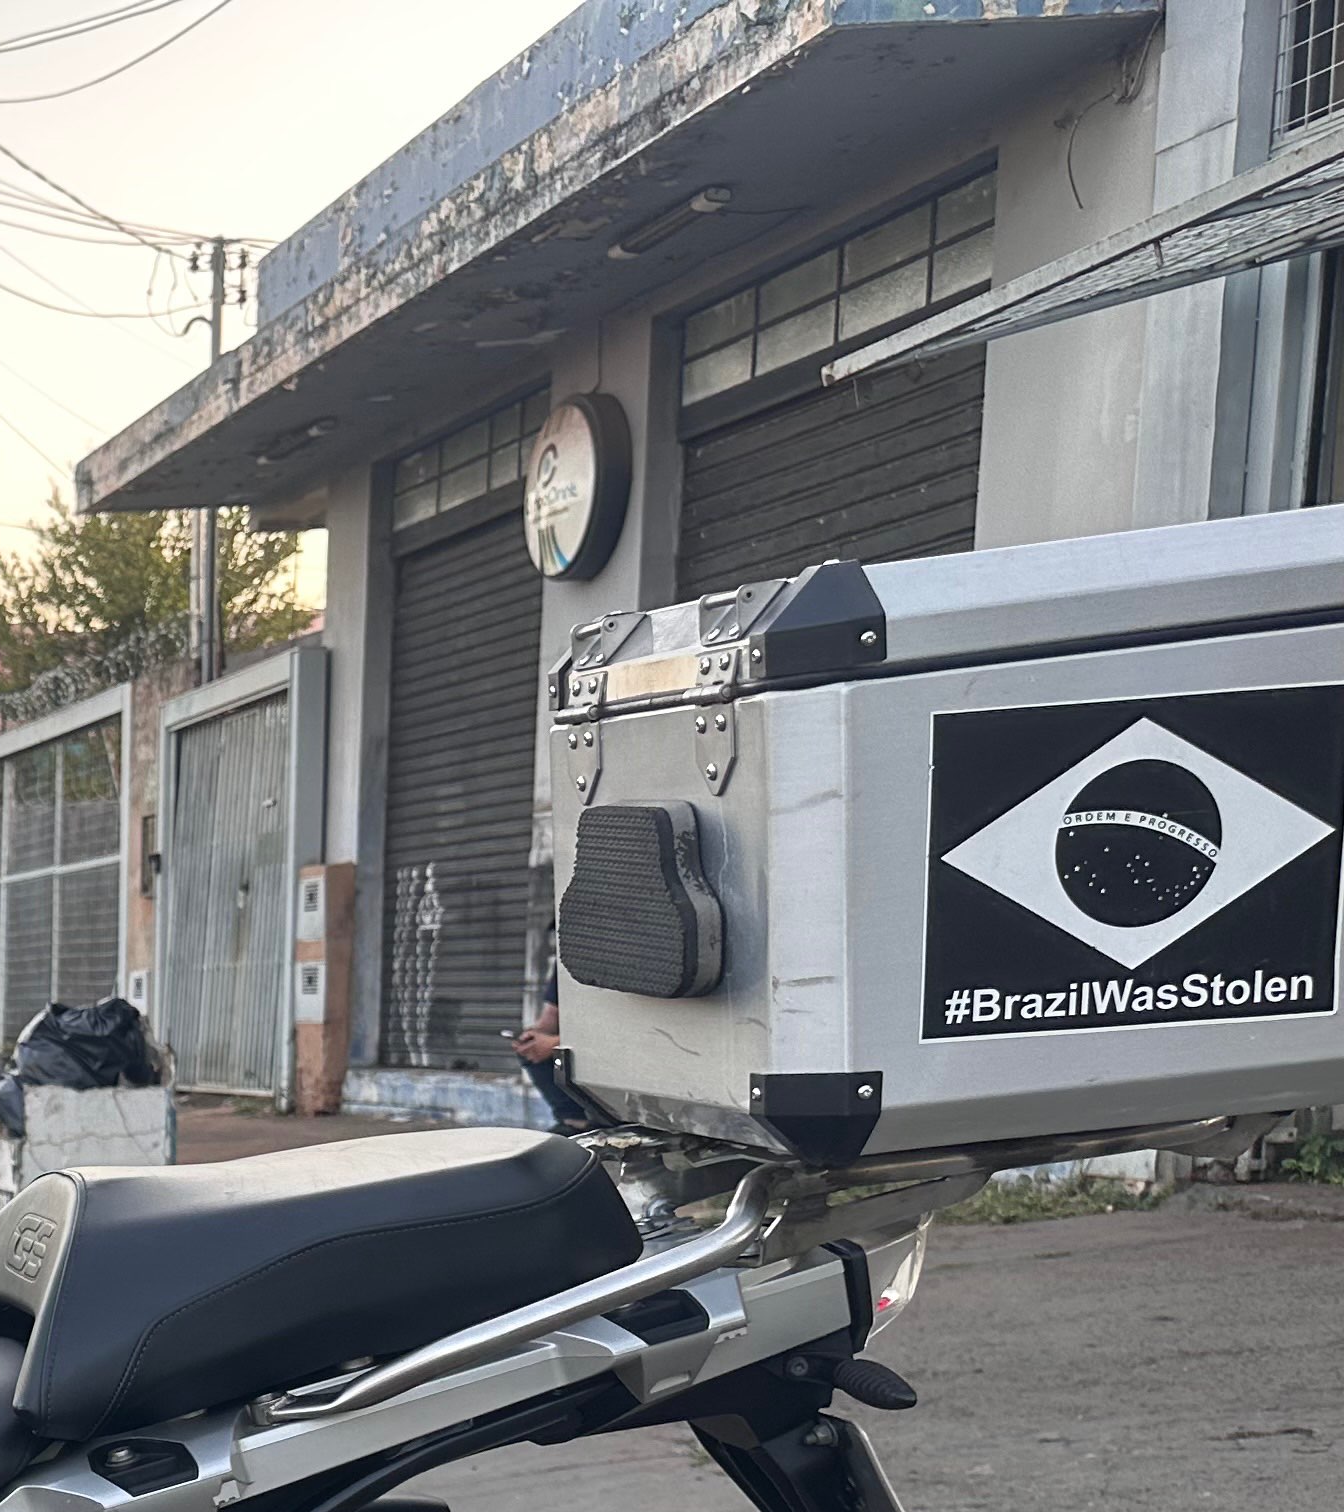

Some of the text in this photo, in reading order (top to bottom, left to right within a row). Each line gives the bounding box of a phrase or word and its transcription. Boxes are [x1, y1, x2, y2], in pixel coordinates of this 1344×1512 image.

[1063, 811, 1218, 858] ORDEM E PROGRESSO
[944, 969, 1314, 1026] #BrazilWasStolen
